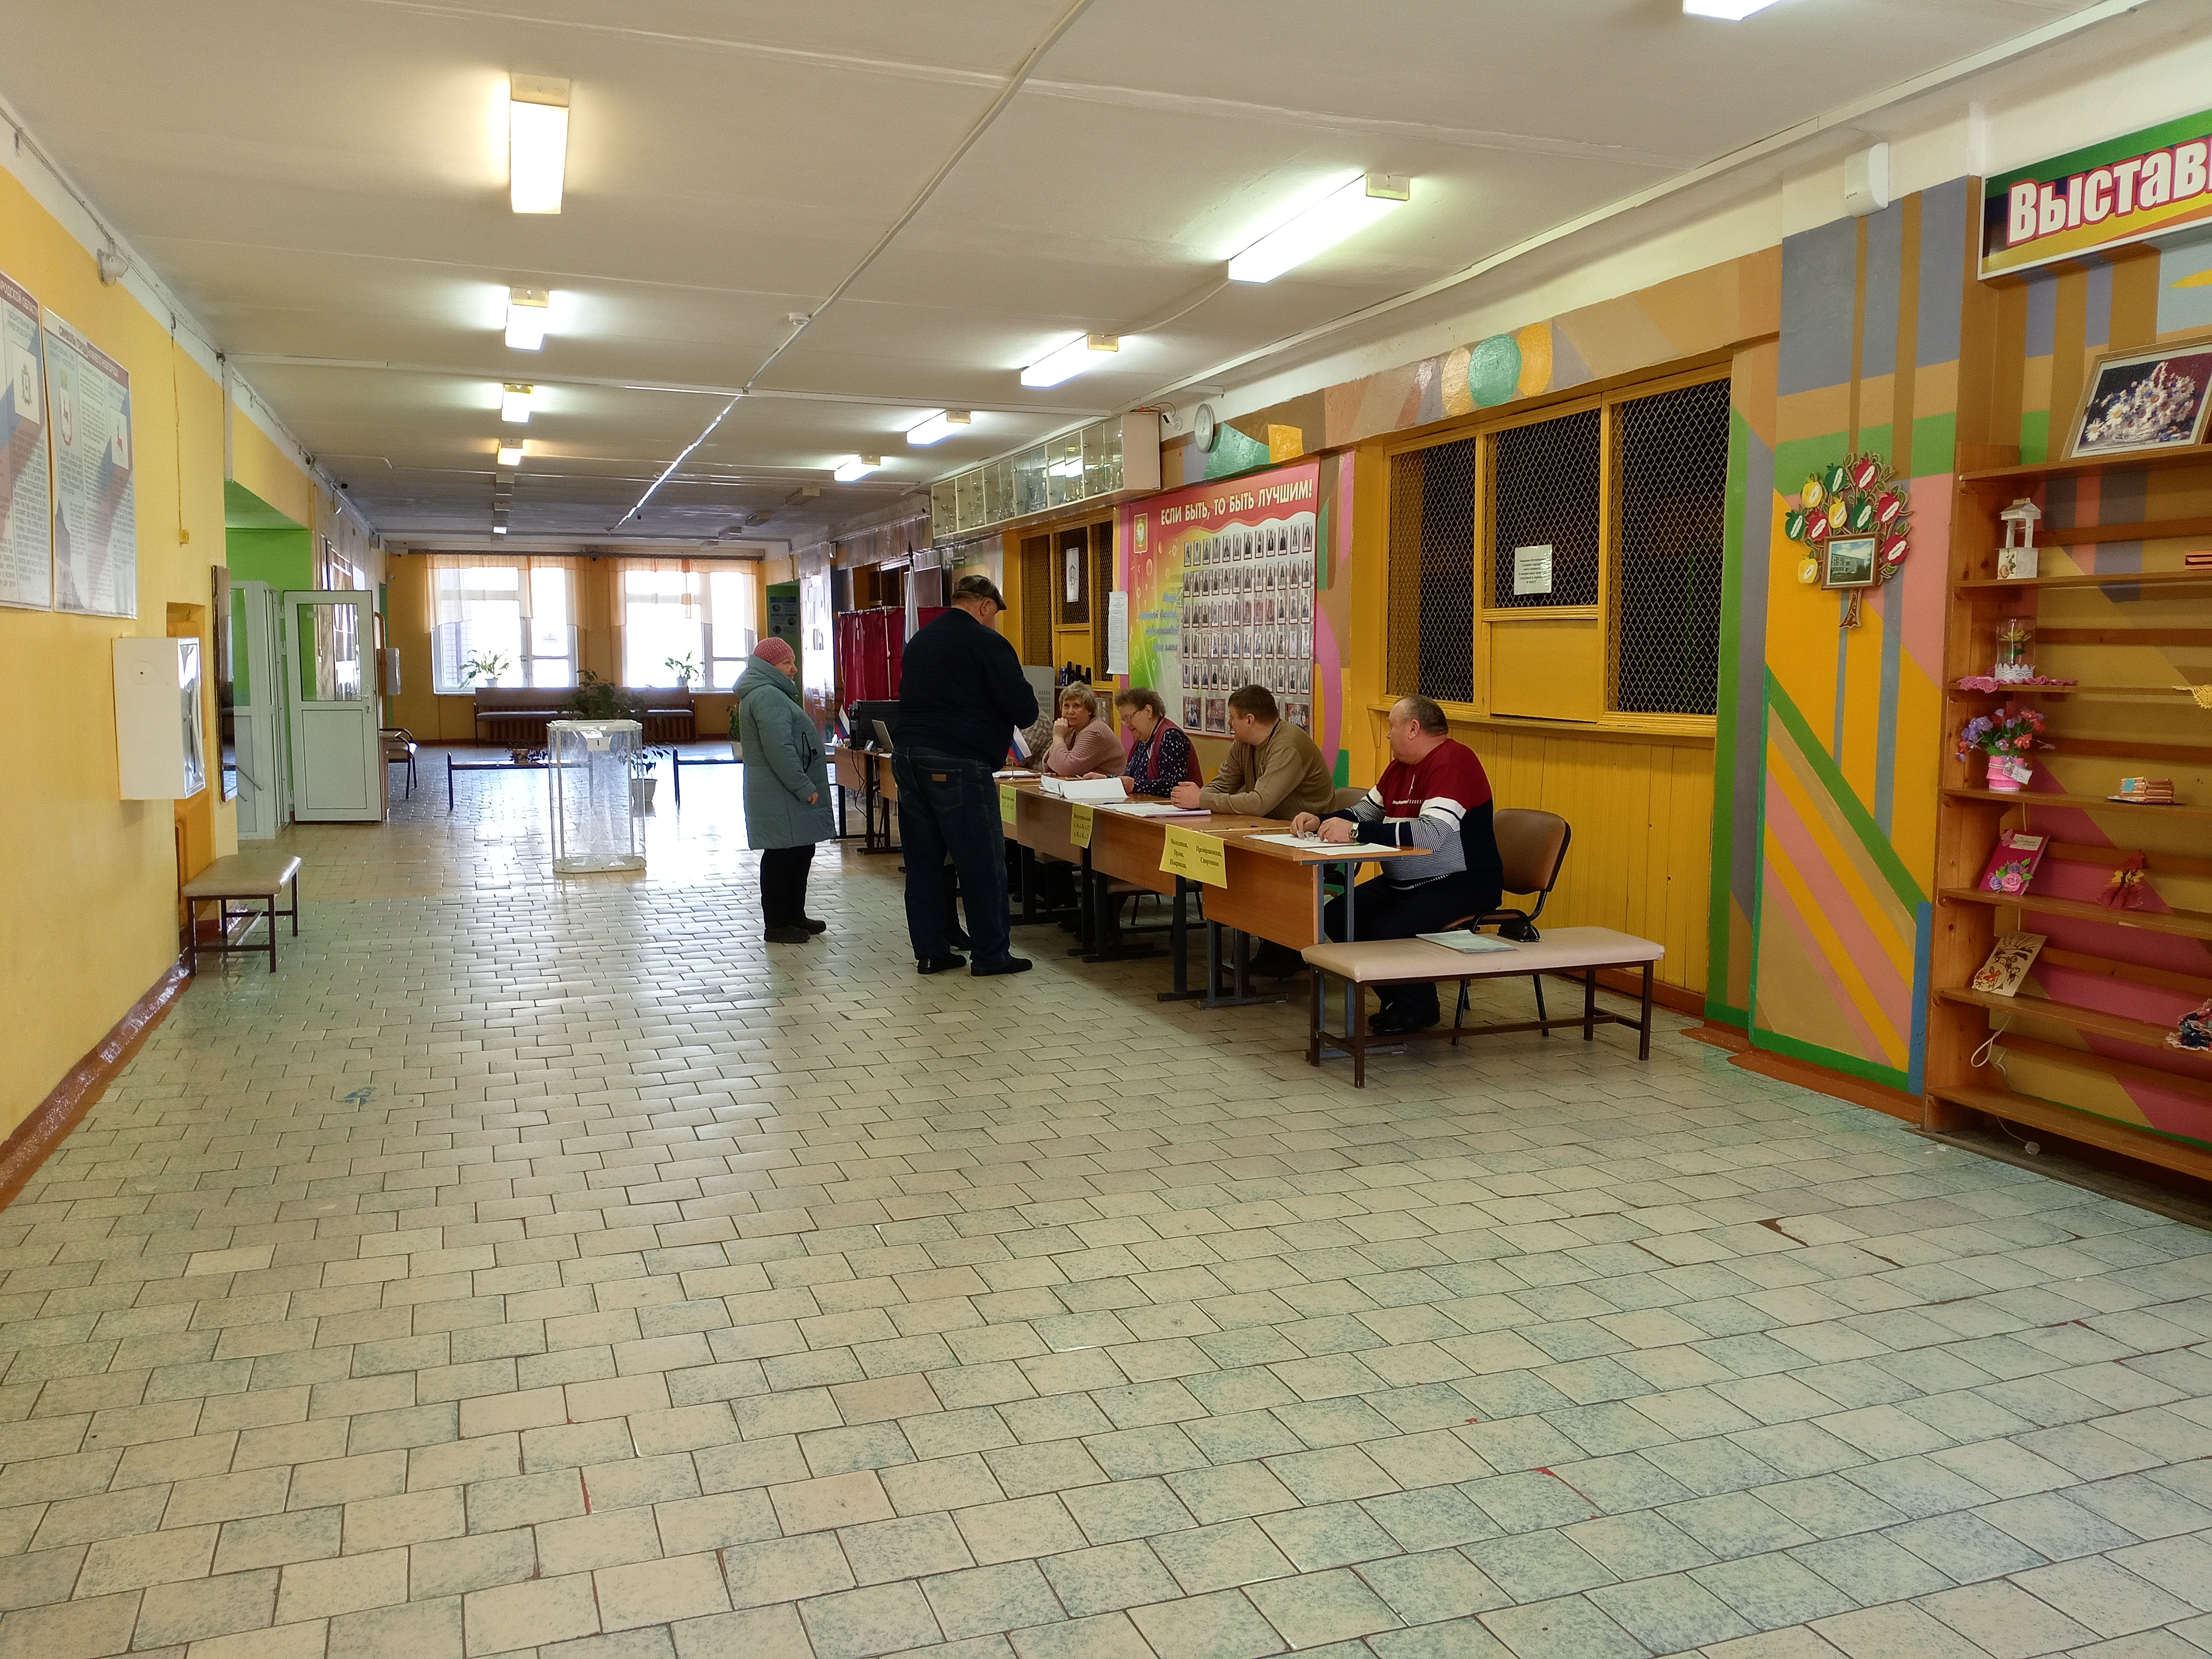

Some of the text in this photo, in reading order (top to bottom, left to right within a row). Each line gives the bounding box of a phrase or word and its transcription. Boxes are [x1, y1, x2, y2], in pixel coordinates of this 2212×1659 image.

[2008, 134, 2212, 246] Выстав
[1161, 479, 1312, 525] ЕСЛИ БЫТЬ, ТО БЫТЬ ЛУЧШИМ!
